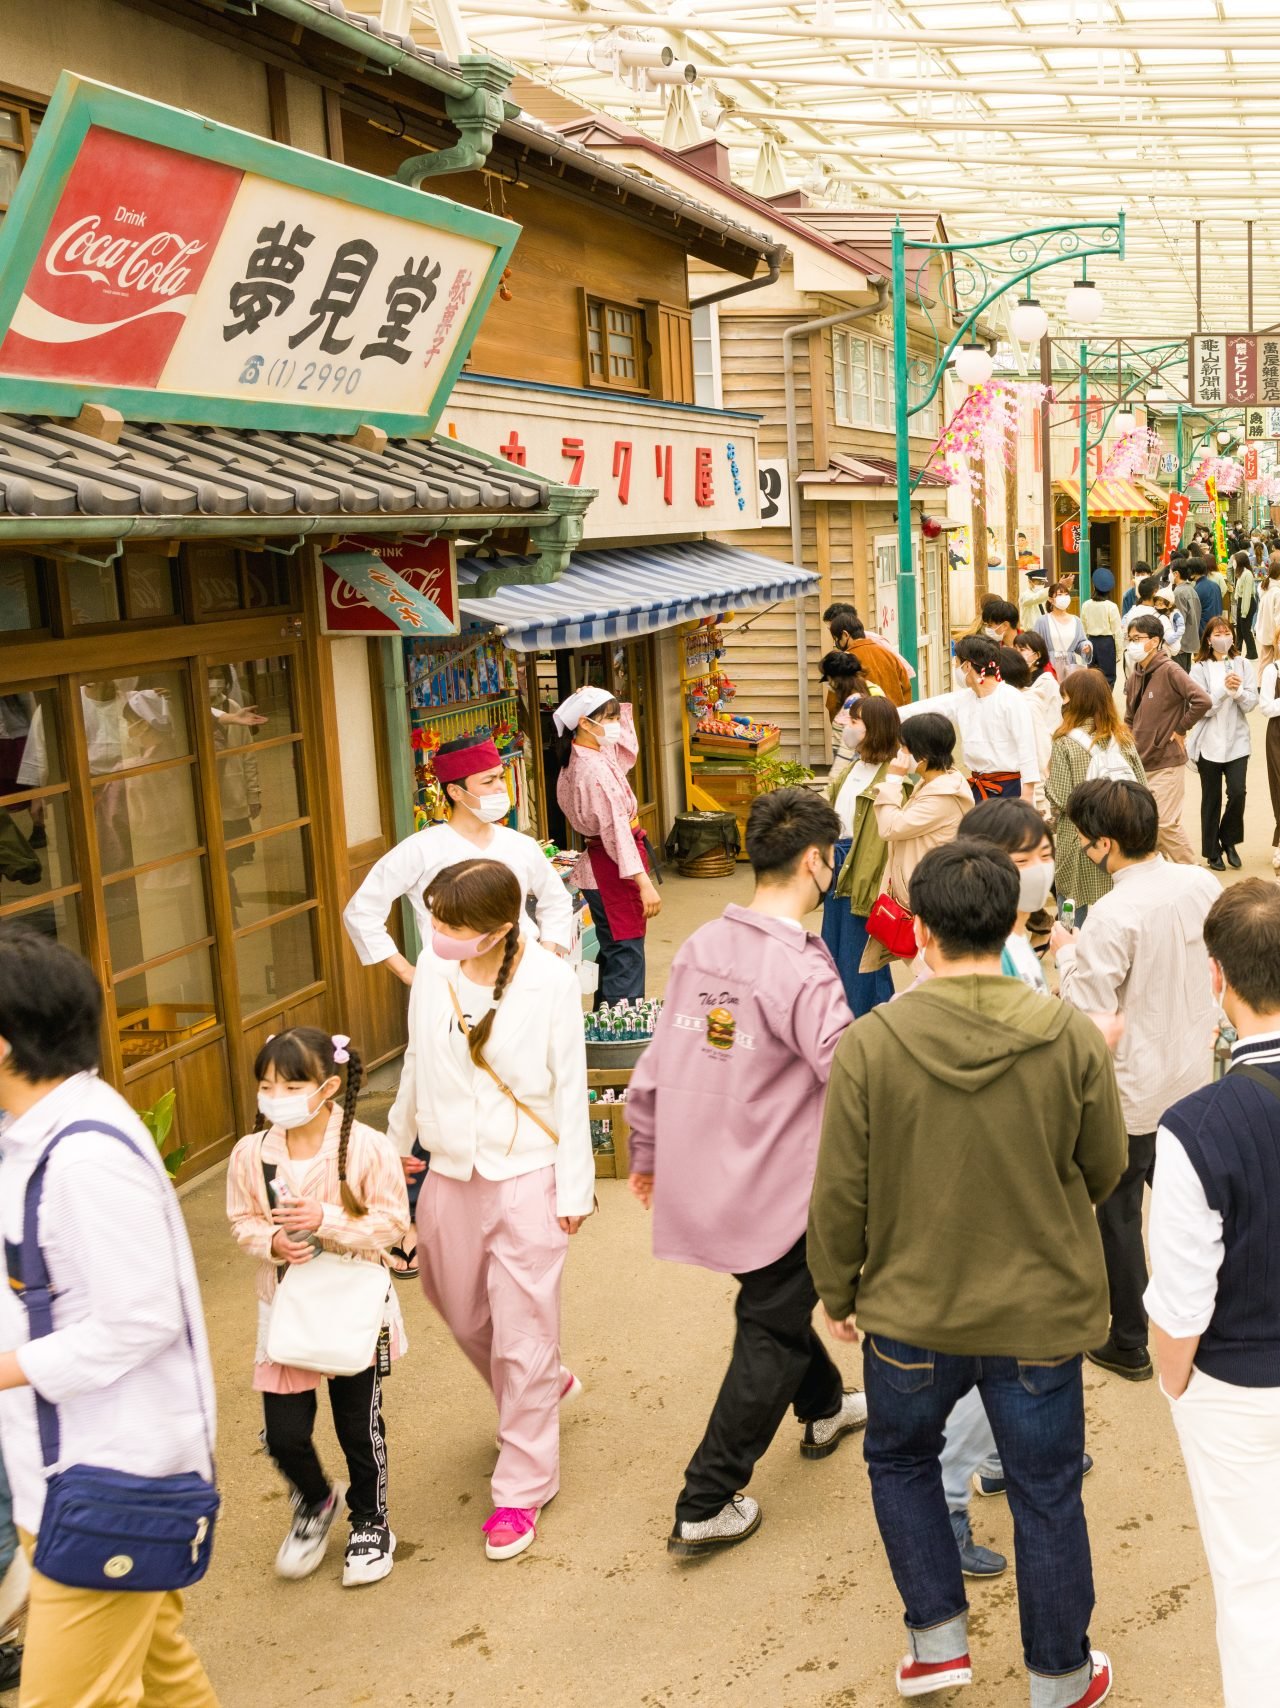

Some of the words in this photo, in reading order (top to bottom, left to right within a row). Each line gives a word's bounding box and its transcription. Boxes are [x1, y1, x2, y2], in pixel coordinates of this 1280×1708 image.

[114, 206, 148, 228] Drink
[45, 214, 209, 296] Coca-Cola
[223, 220, 442, 365] 夢見堂
[371, 547, 404, 558] RINK
[351, 1531, 382, 1545] Melody
